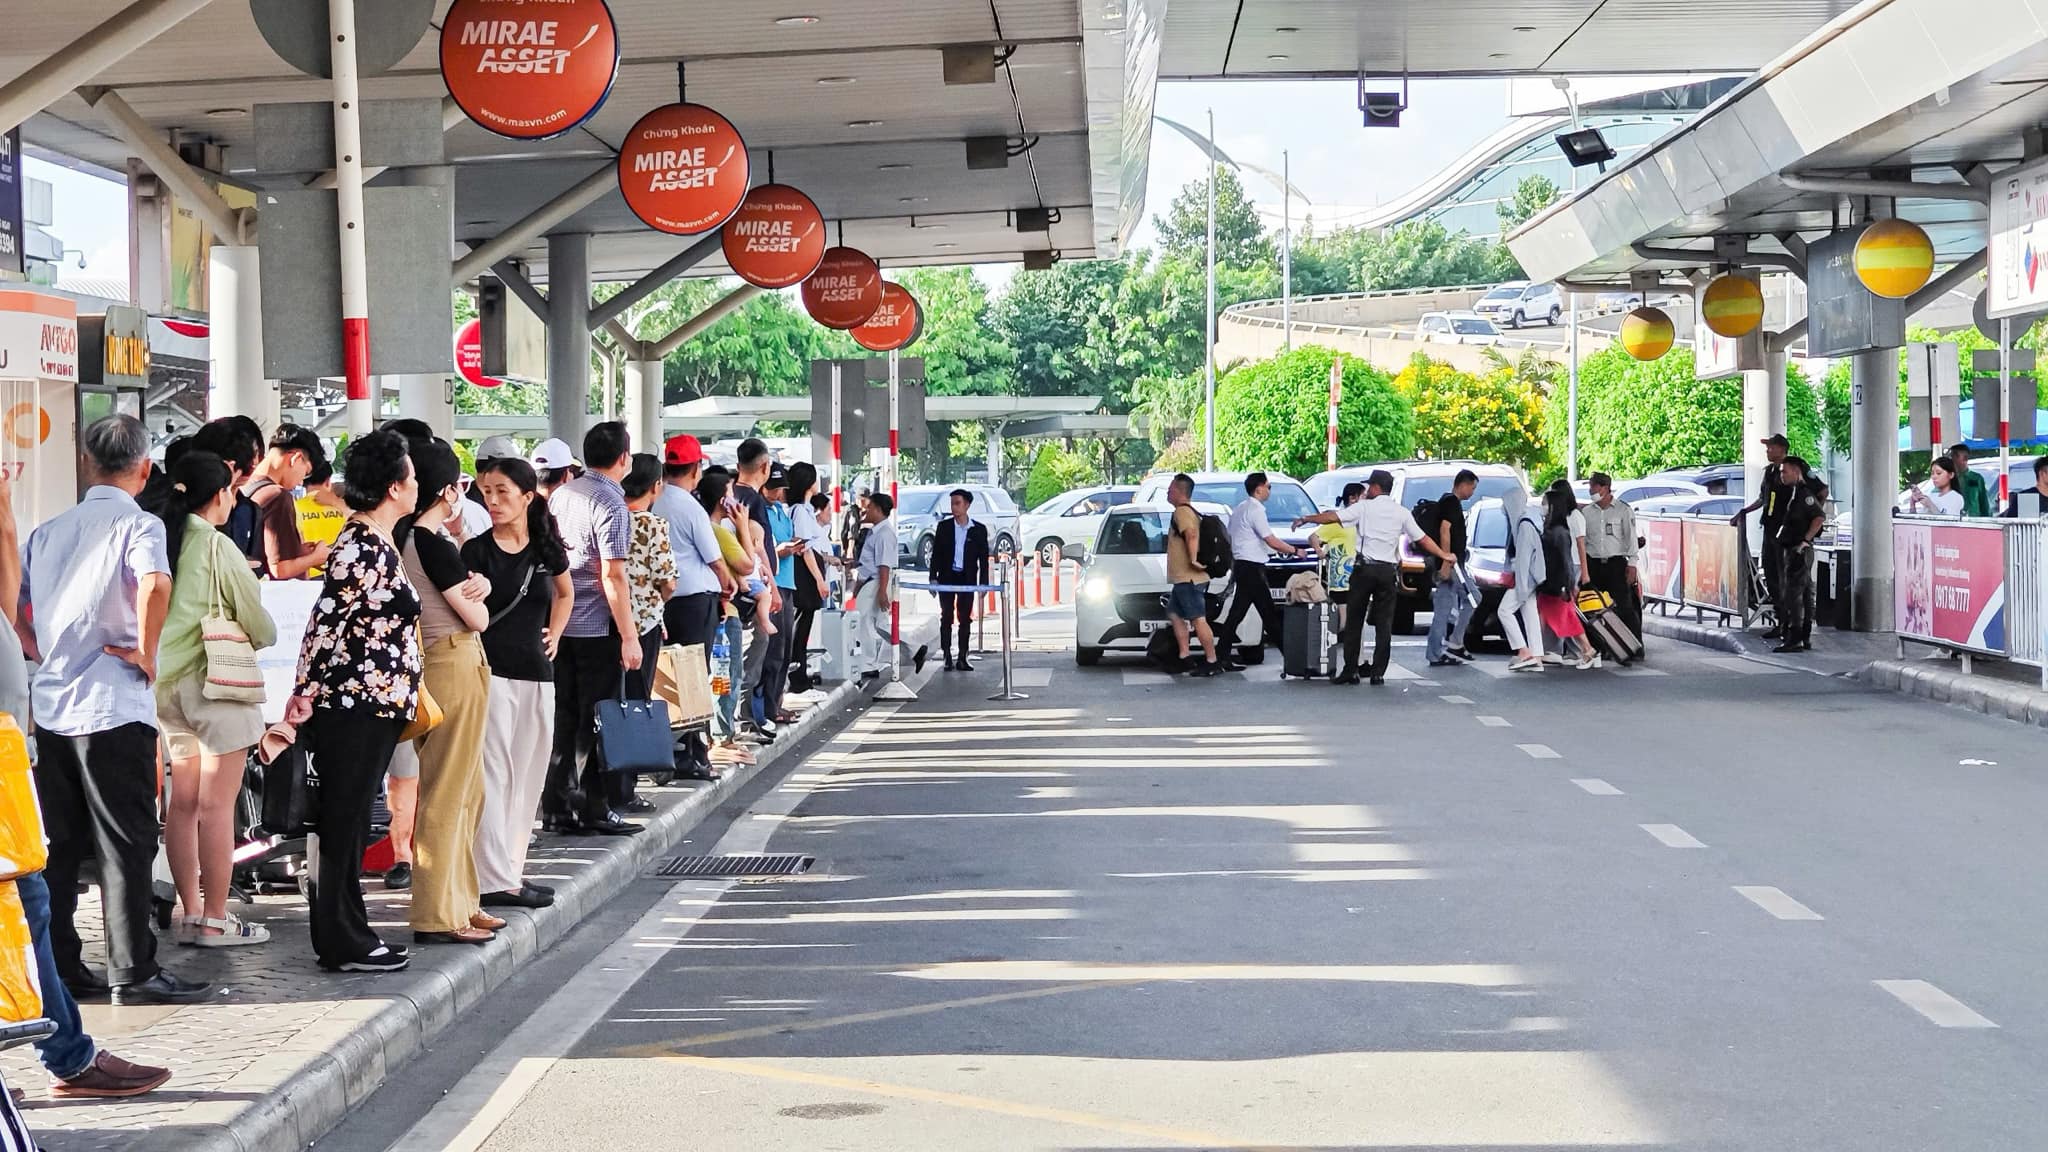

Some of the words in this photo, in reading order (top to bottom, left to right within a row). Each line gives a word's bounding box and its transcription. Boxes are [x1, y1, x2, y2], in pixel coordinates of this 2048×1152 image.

[460, 21, 559, 46] MIRAE
[476, 48, 571, 74] ASSET
[480, 108, 567, 127] www.masvn.com
[643, 127, 679, 140] Chứng
[634, 147, 706, 173] MIRAE
[649, 167, 718, 192] ASSET
[735, 220, 793, 236] MIRAE
[745, 236, 801, 253] ASSET
[811, 275, 857, 290] MIRAE
[820, 287, 865, 303] ASSET
[302, 511, 320, 521] HAI
